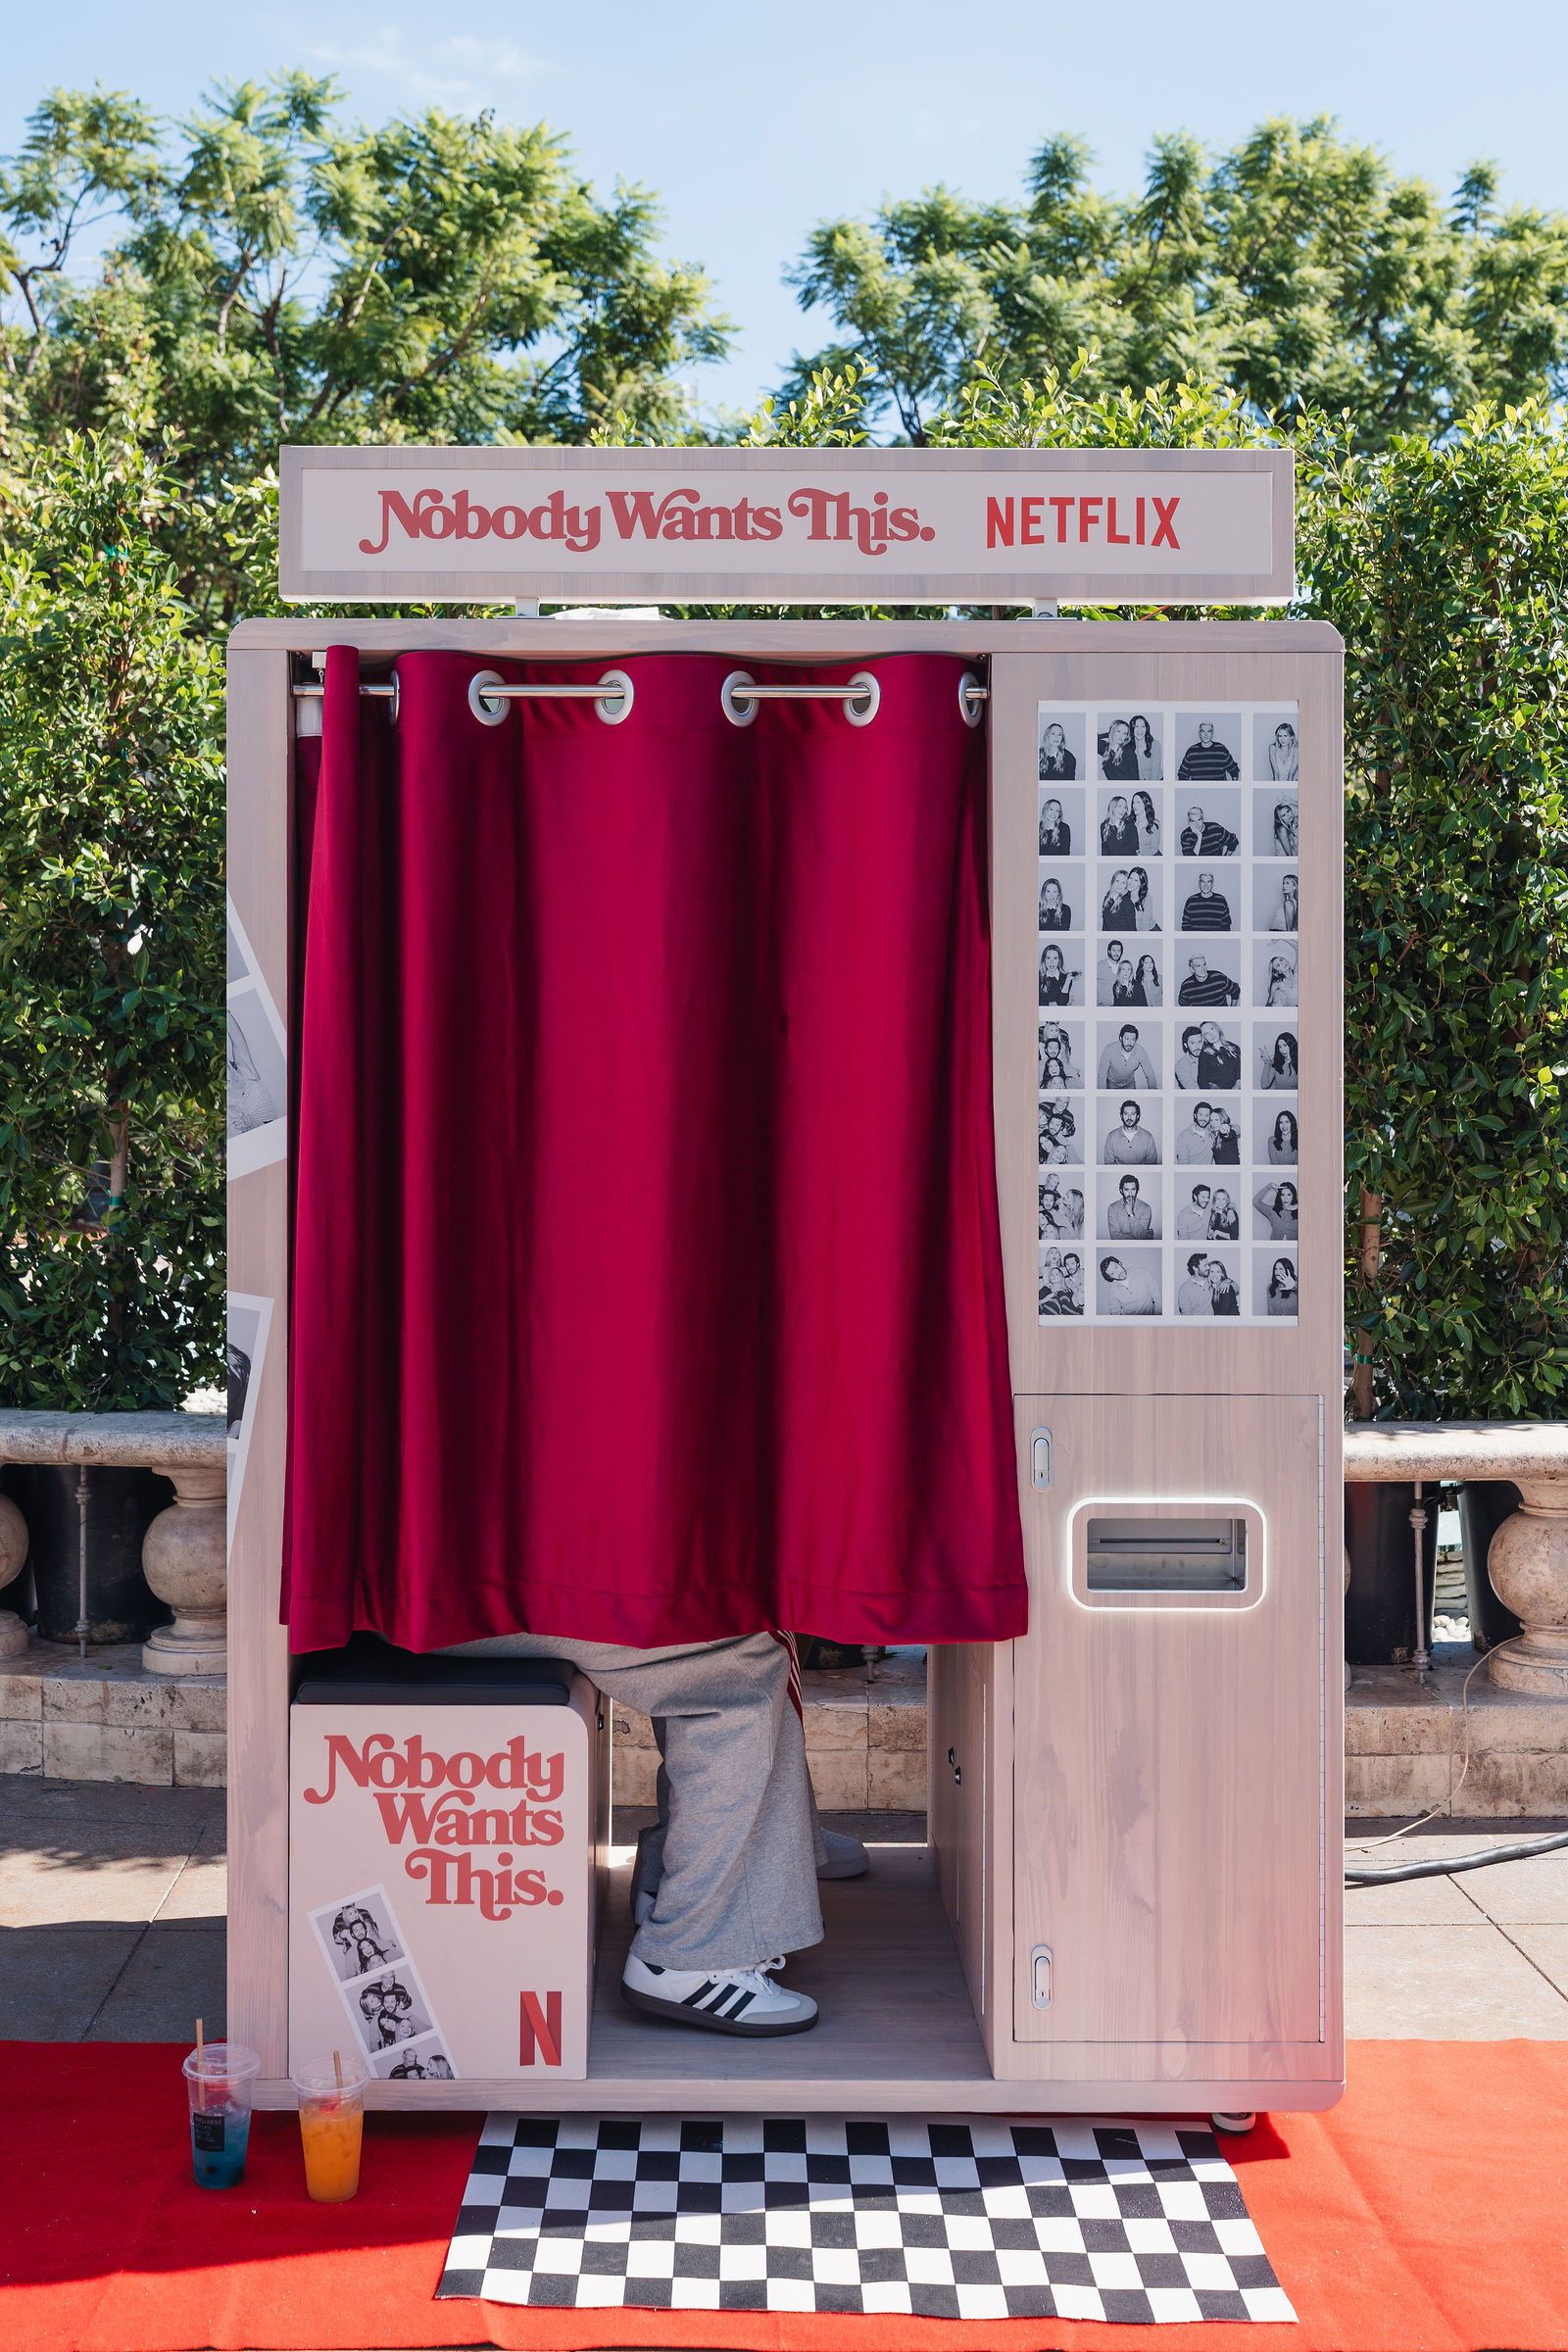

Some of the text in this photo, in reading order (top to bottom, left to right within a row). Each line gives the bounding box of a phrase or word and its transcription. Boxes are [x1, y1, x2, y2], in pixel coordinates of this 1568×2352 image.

[359, 488, 935, 555] Nobody Wants This.
[986, 496, 1181, 550] NETFLIX
[304, 1734, 564, 1804] Nobody
[373, 1790, 564, 1846] Wants
[405, 1847, 564, 1921] This.
[519, 1990, 563, 2067] N
